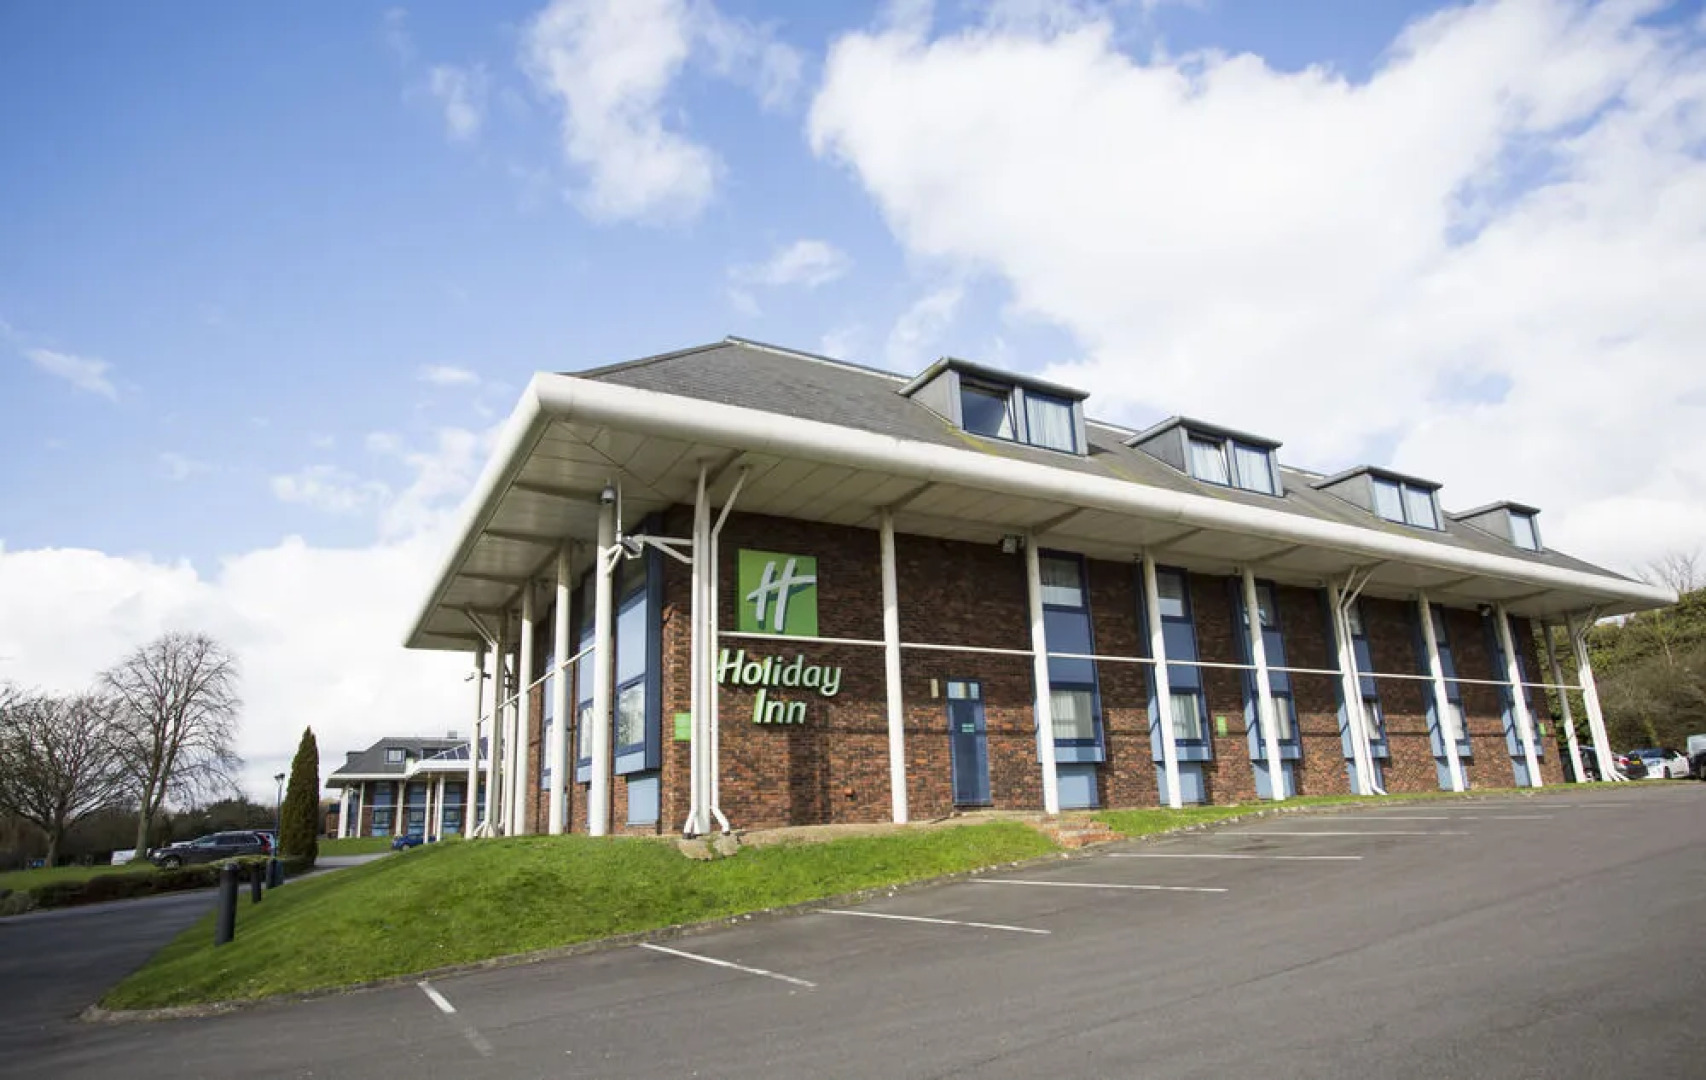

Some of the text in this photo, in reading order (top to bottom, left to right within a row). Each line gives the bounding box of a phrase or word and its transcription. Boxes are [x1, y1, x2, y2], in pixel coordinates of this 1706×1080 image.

[746, 557, 817, 633] H
[717, 648, 842, 697] Holiday
[753, 688, 807, 724] Inn
